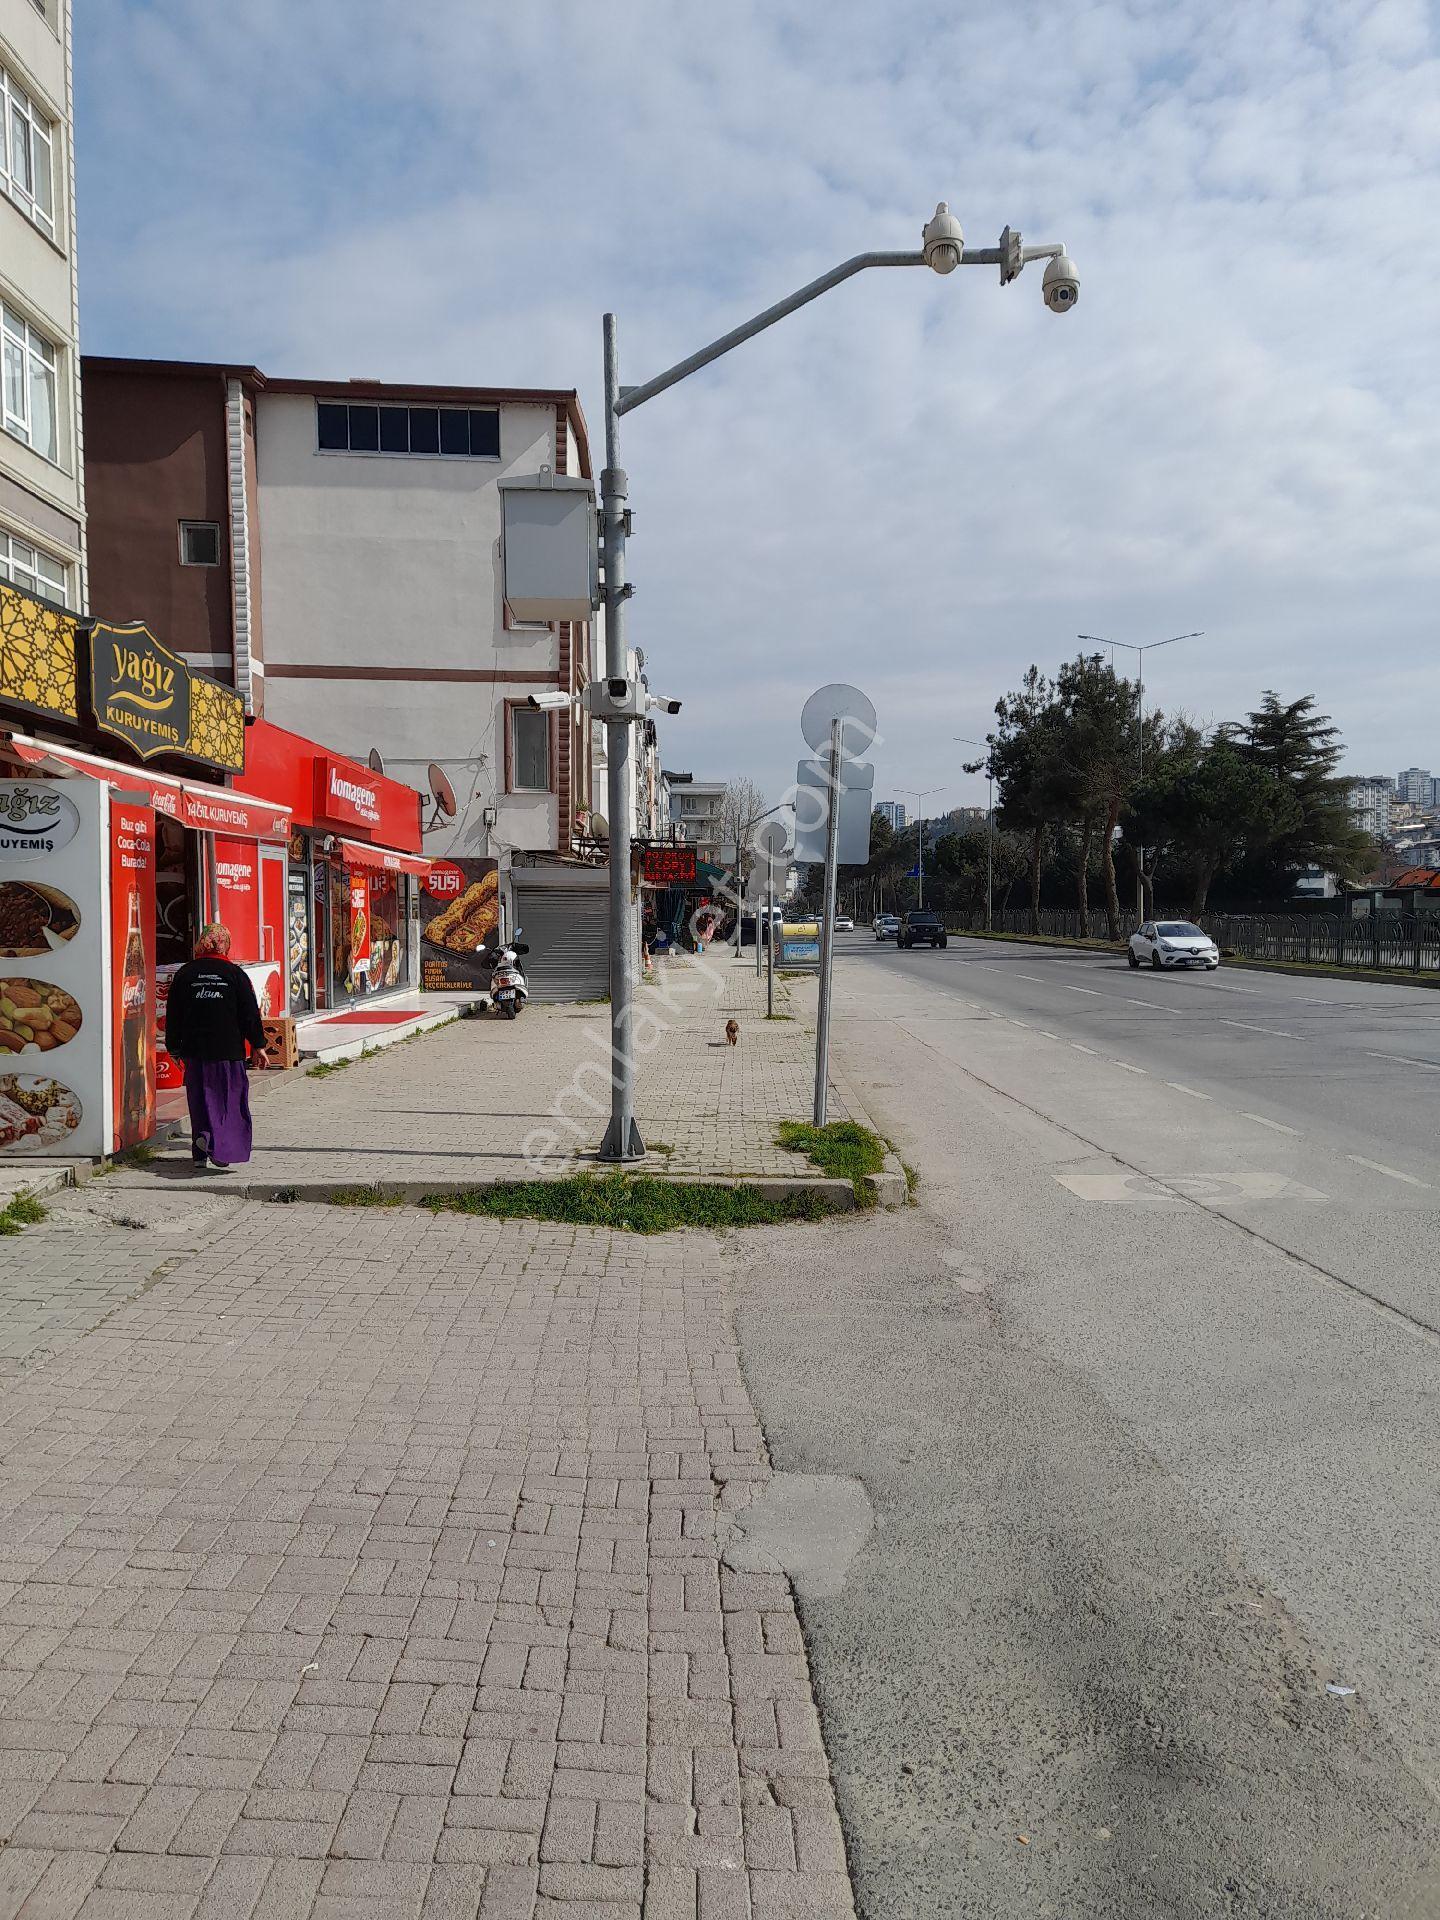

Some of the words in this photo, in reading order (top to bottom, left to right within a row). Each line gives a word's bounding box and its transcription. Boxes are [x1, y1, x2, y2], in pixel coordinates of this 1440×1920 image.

[111, 643, 174, 697] yağız
[106, 705, 179, 744] KURUYEMİŞ
[330, 767, 375, 811] komagene
[120, 817, 135, 832] Buz
[134, 820, 148, 835] gibi
[186, 800, 209, 820] YAĞIZ
[209, 808, 248, 829] KURUYEMİŞ
[0, 839, 54, 852] UYEMİŞ
[117, 836, 151, 852] Coca-Cola
[121, 855, 147, 869] Burada!
